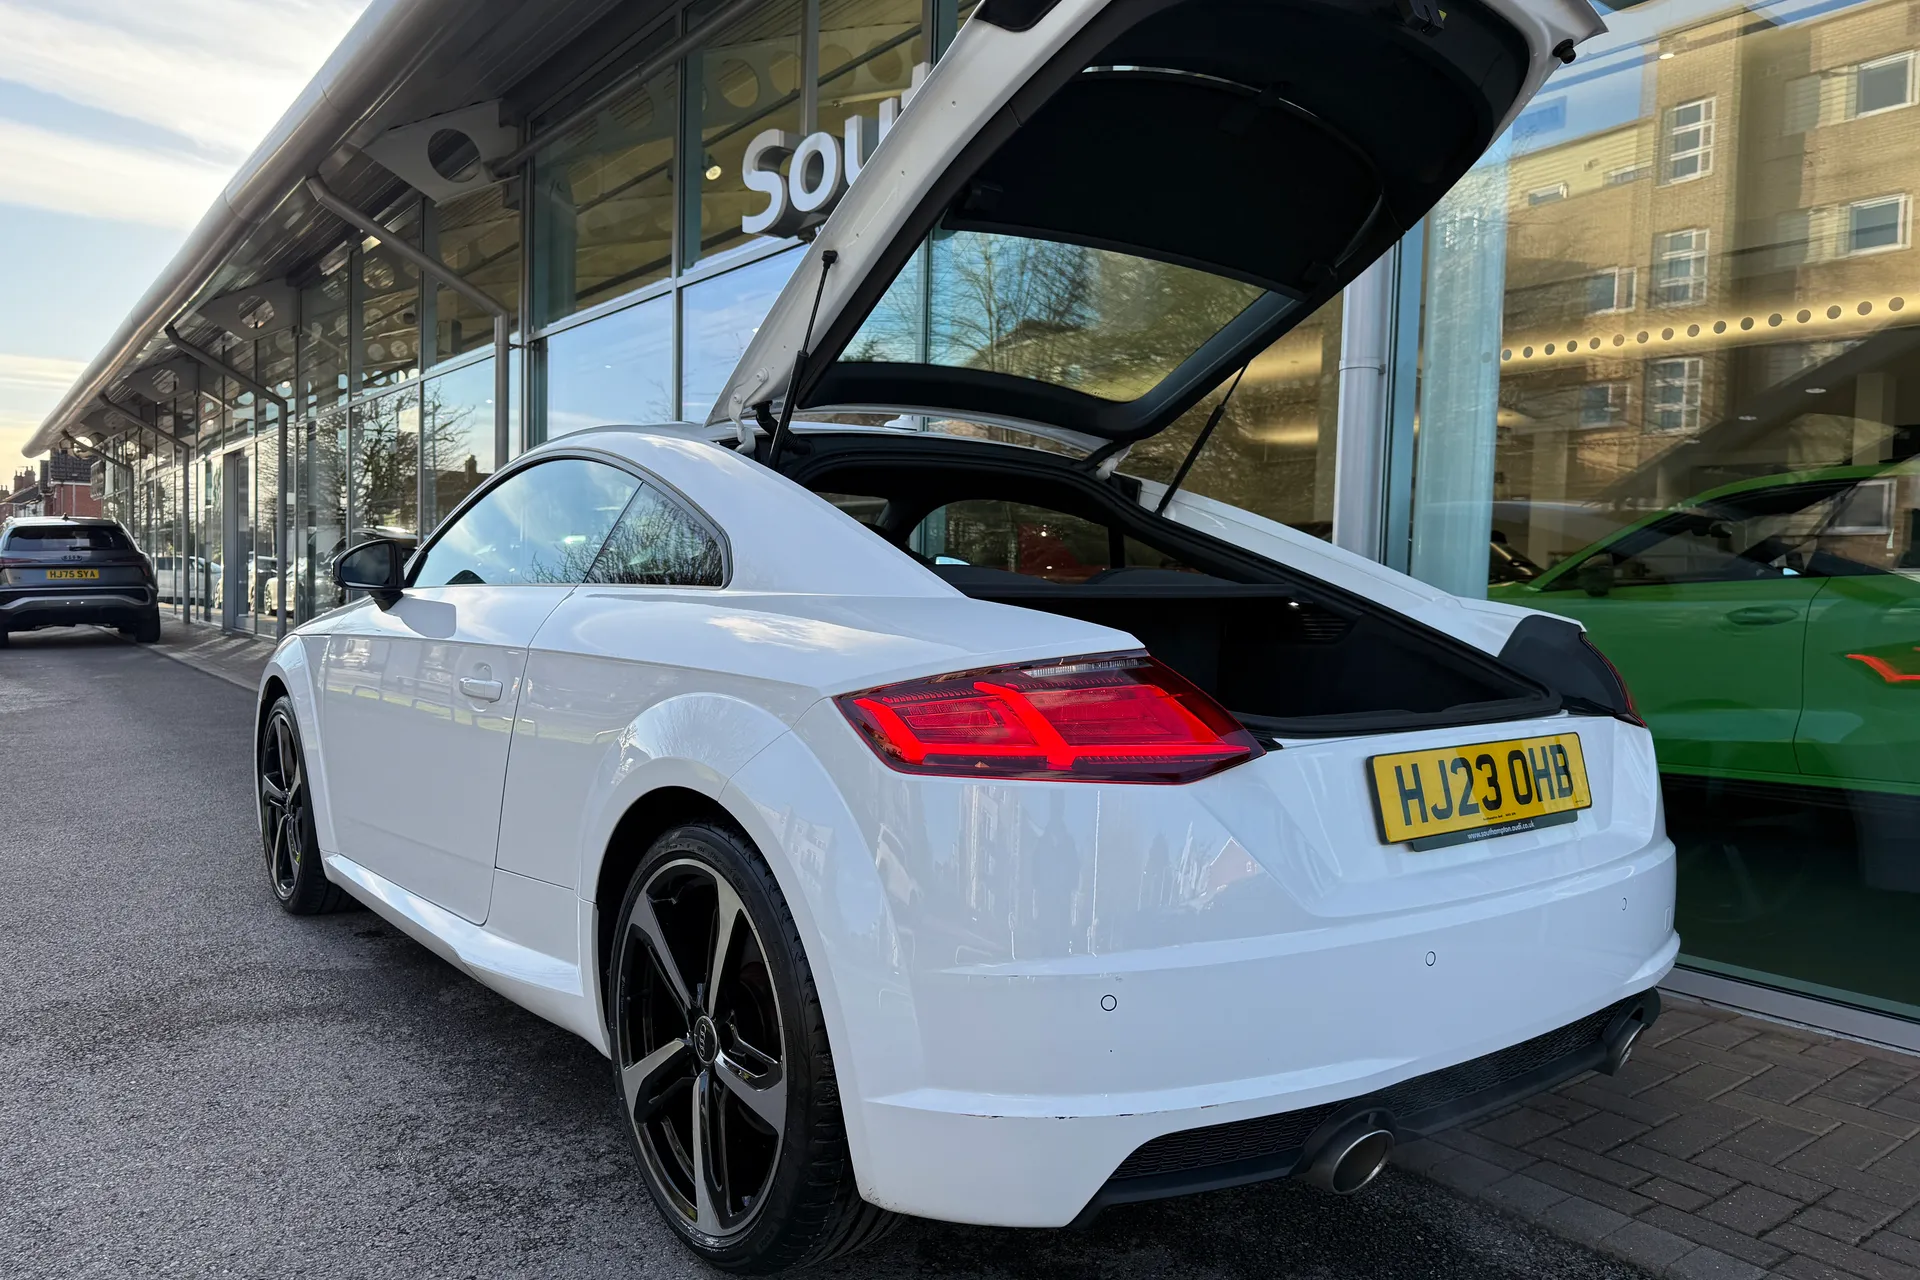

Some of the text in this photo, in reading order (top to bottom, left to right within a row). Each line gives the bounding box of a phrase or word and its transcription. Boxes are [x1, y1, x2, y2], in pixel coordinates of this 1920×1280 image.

[50, 570, 95, 578] HJ75 SYA
[1394, 744, 1573, 825] HJ23 OHB
